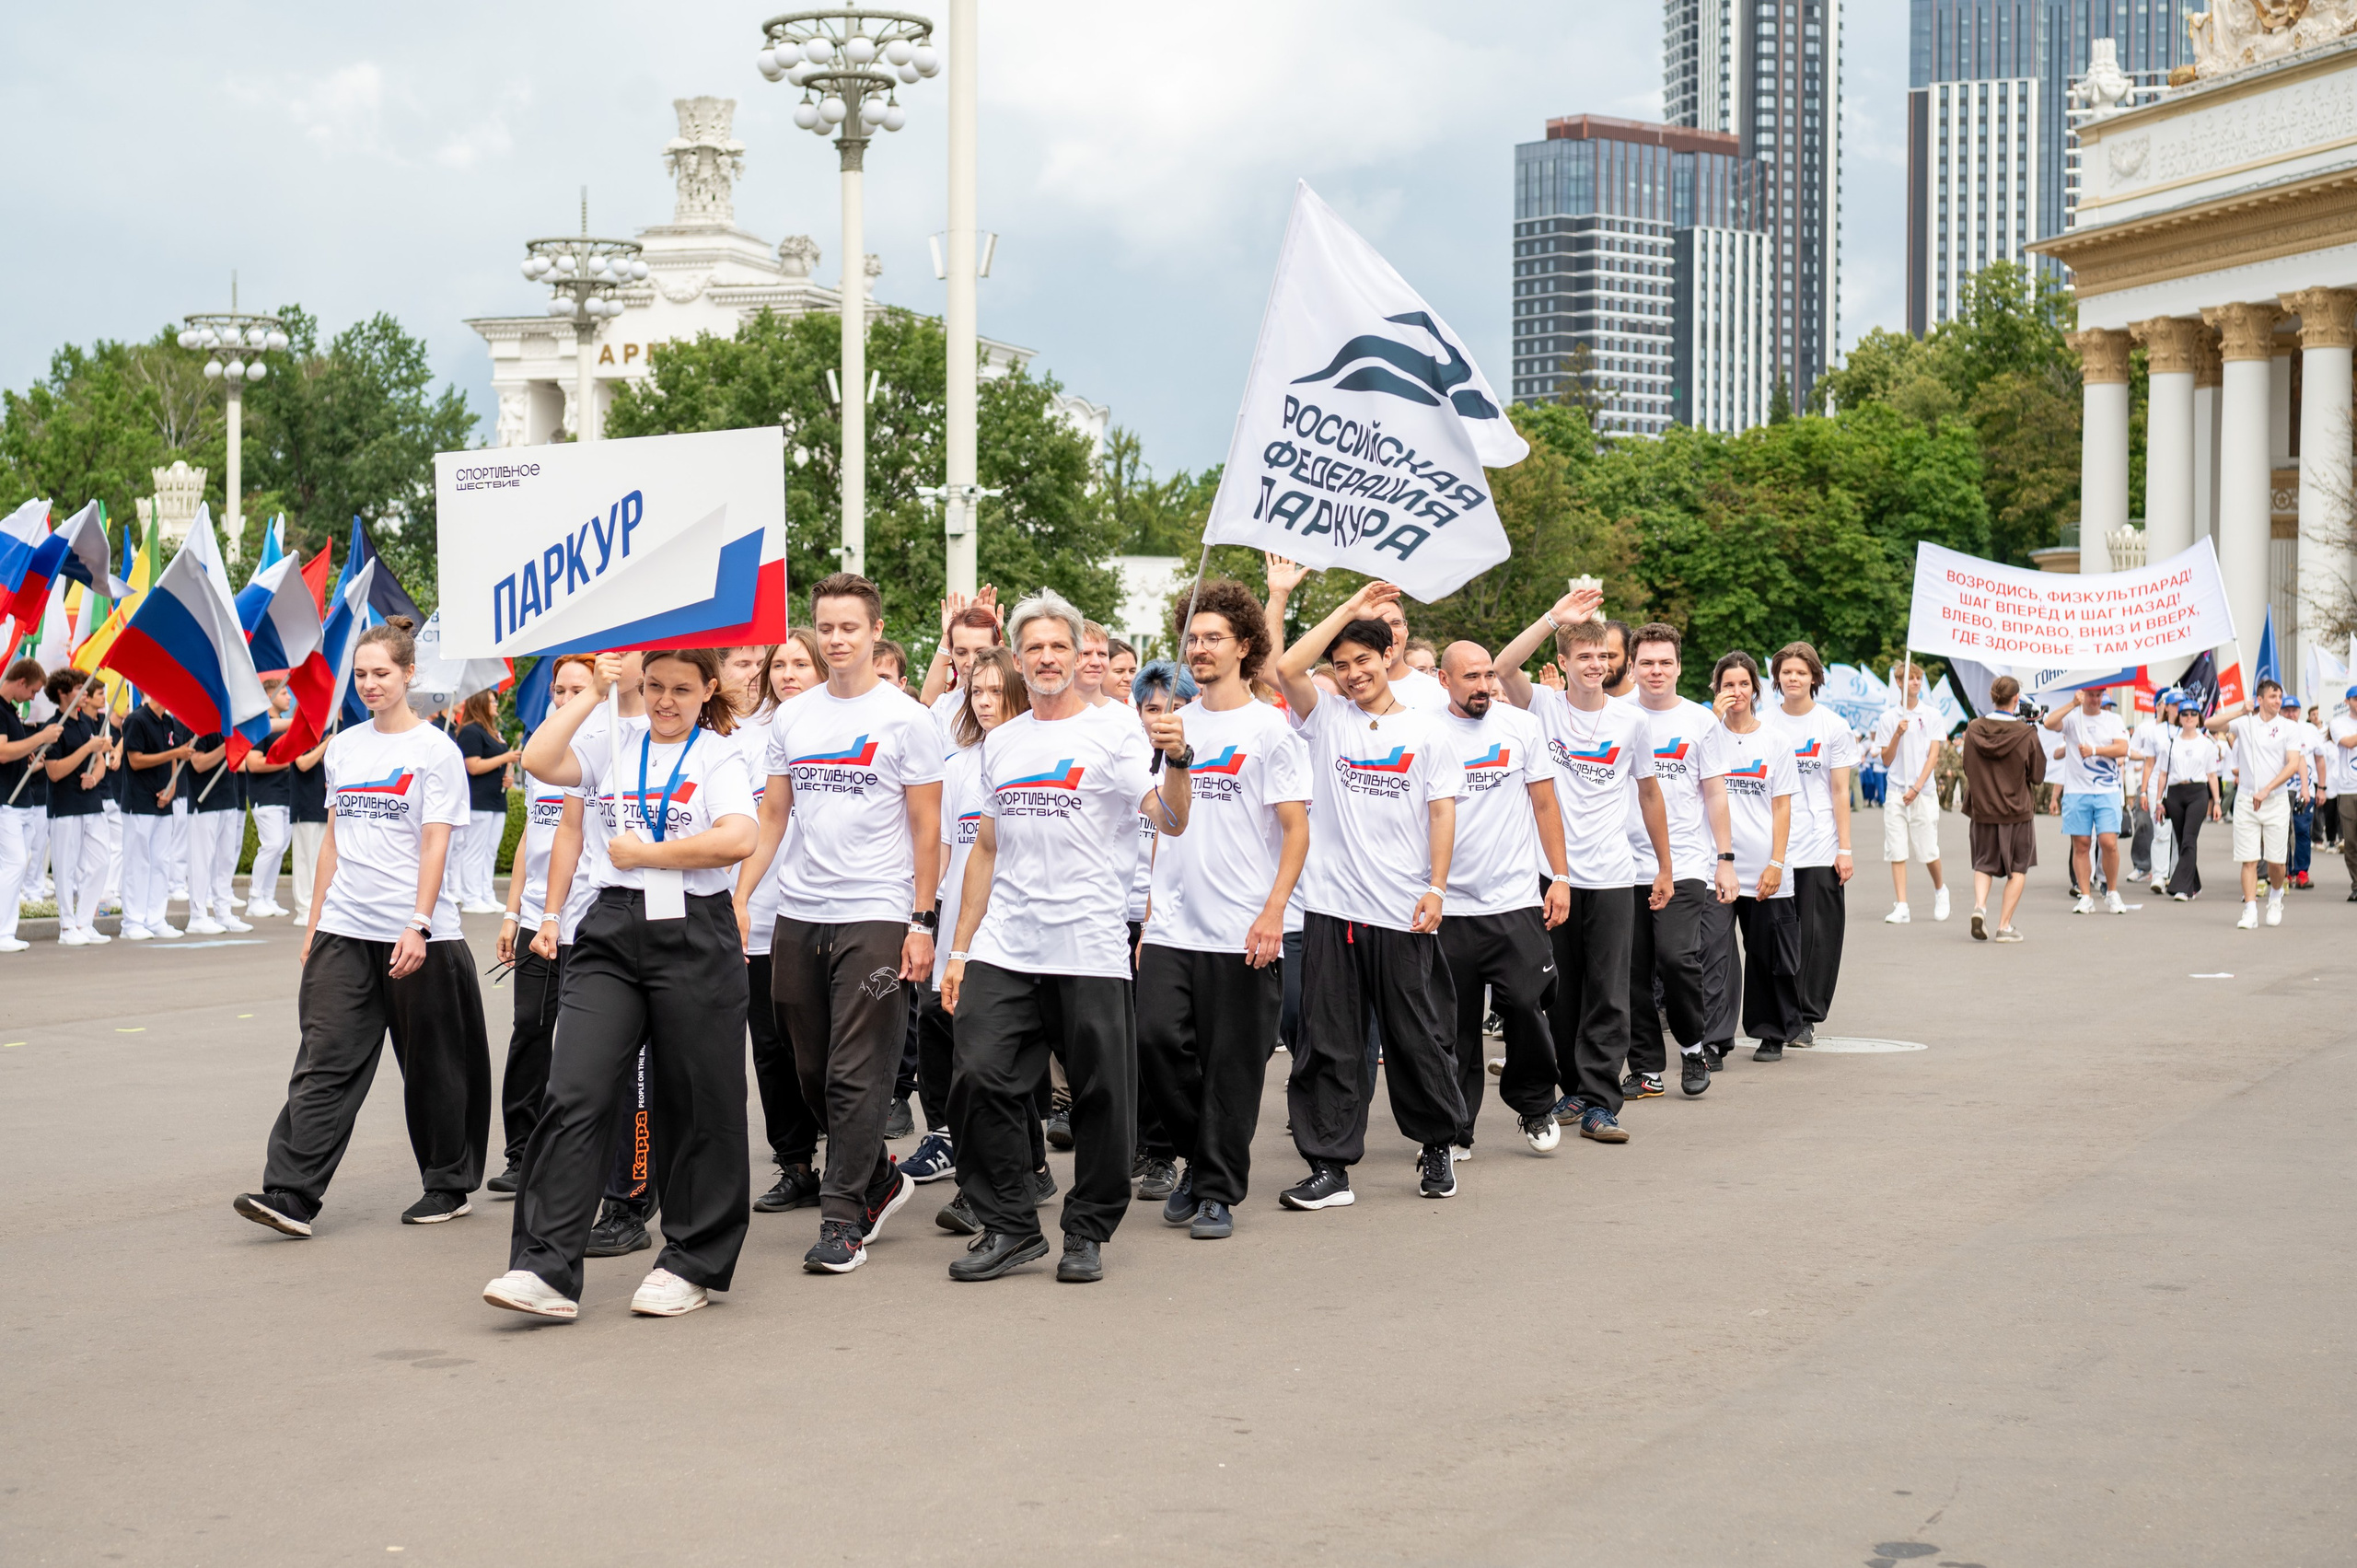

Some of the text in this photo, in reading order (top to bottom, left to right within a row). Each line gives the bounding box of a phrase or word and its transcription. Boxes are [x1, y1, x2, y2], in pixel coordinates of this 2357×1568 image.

[2301, 116, 2357, 145] РЕСПУБ
[1283, 393, 1487, 511] РОССИЙСКАЯ
[456, 479, 520, 491] ШЕСТВИЕ
[1263, 440, 1459, 528] ФЕДЕРАЦИЯ
[1253, 475, 1431, 562] ПАРКУРА
[493, 489, 644, 645] ПАРКУР
[1946, 567, 2193, 604] ВОЗРОДИСЬ, ФИЗКУЛЬТПАРАД!
[1942, 605, 2200, 640] ВЛЕВО, ВПРАВО, ВНИЗ И ВВЕРХ,
[1959, 592, 2181, 621] ШАГ ВПЕРЁД И ШАГ НАЗАД!
[1952, 628, 1980, 646] ГДЕ
[1985, 635, 2074, 656] ЗДОРОВЬЕ
[2093, 641, 2129, 655] ТАМ
[2133, 625, 2191, 653] УСПЕХ!
[2035, 669, 2068, 690] ГОН
[637, 1071, 644, 1082] ON
[633, 1110, 650, 1180] Kappa
